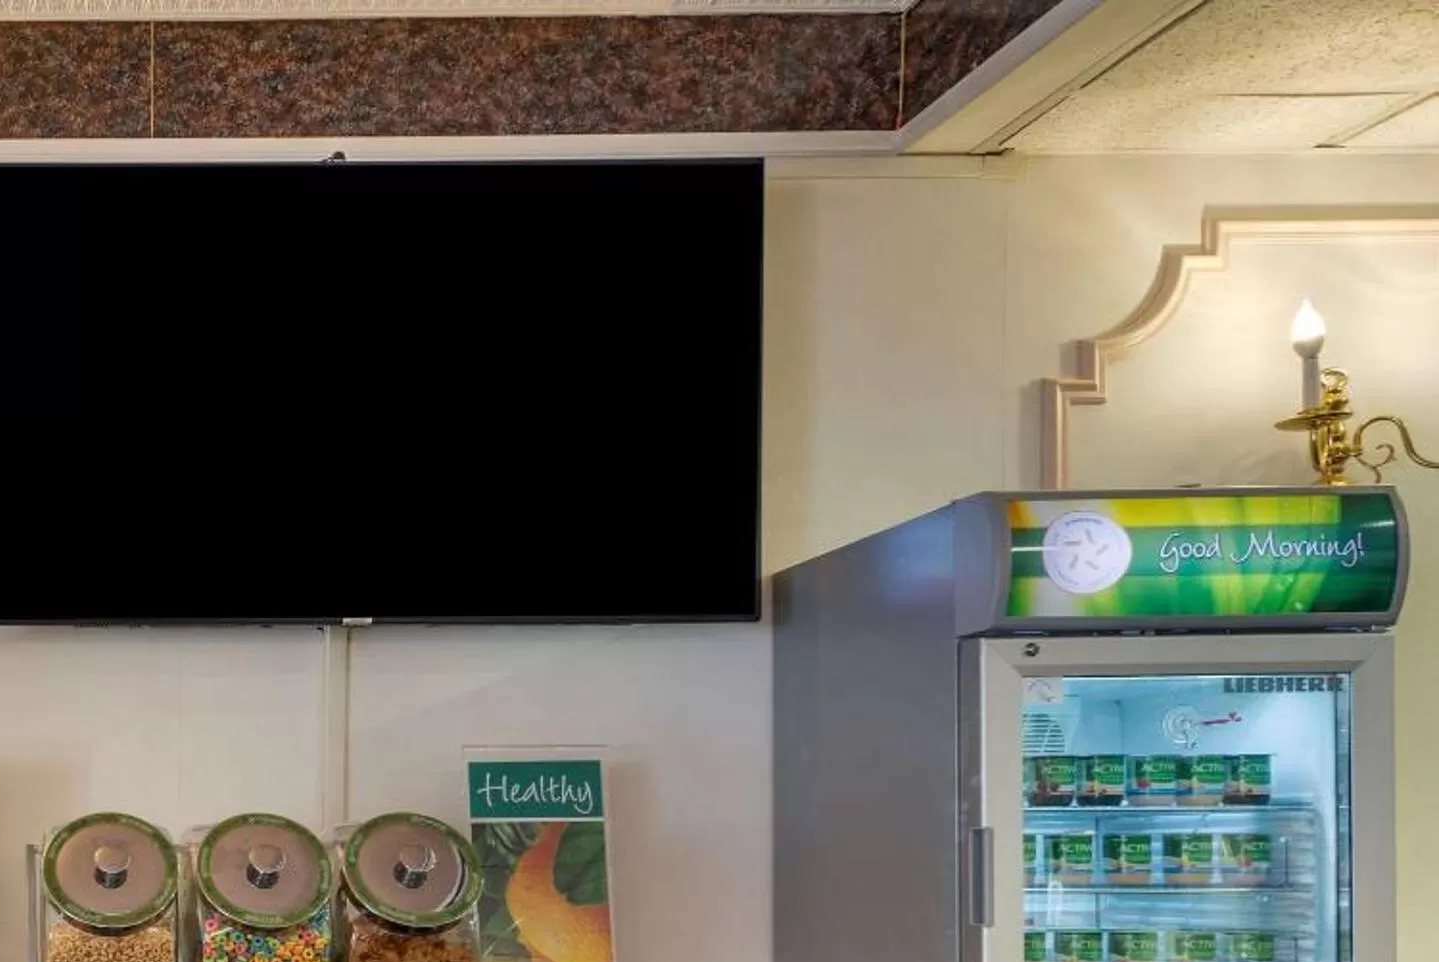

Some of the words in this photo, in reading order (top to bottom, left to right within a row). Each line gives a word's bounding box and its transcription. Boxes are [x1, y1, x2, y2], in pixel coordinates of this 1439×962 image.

[1160, 532, 1220, 573] Good
[1231, 529, 1365, 568] Morning!
[1223, 677, 1344, 693] LIEBHERR
[476, 772, 594, 815] Healthy
